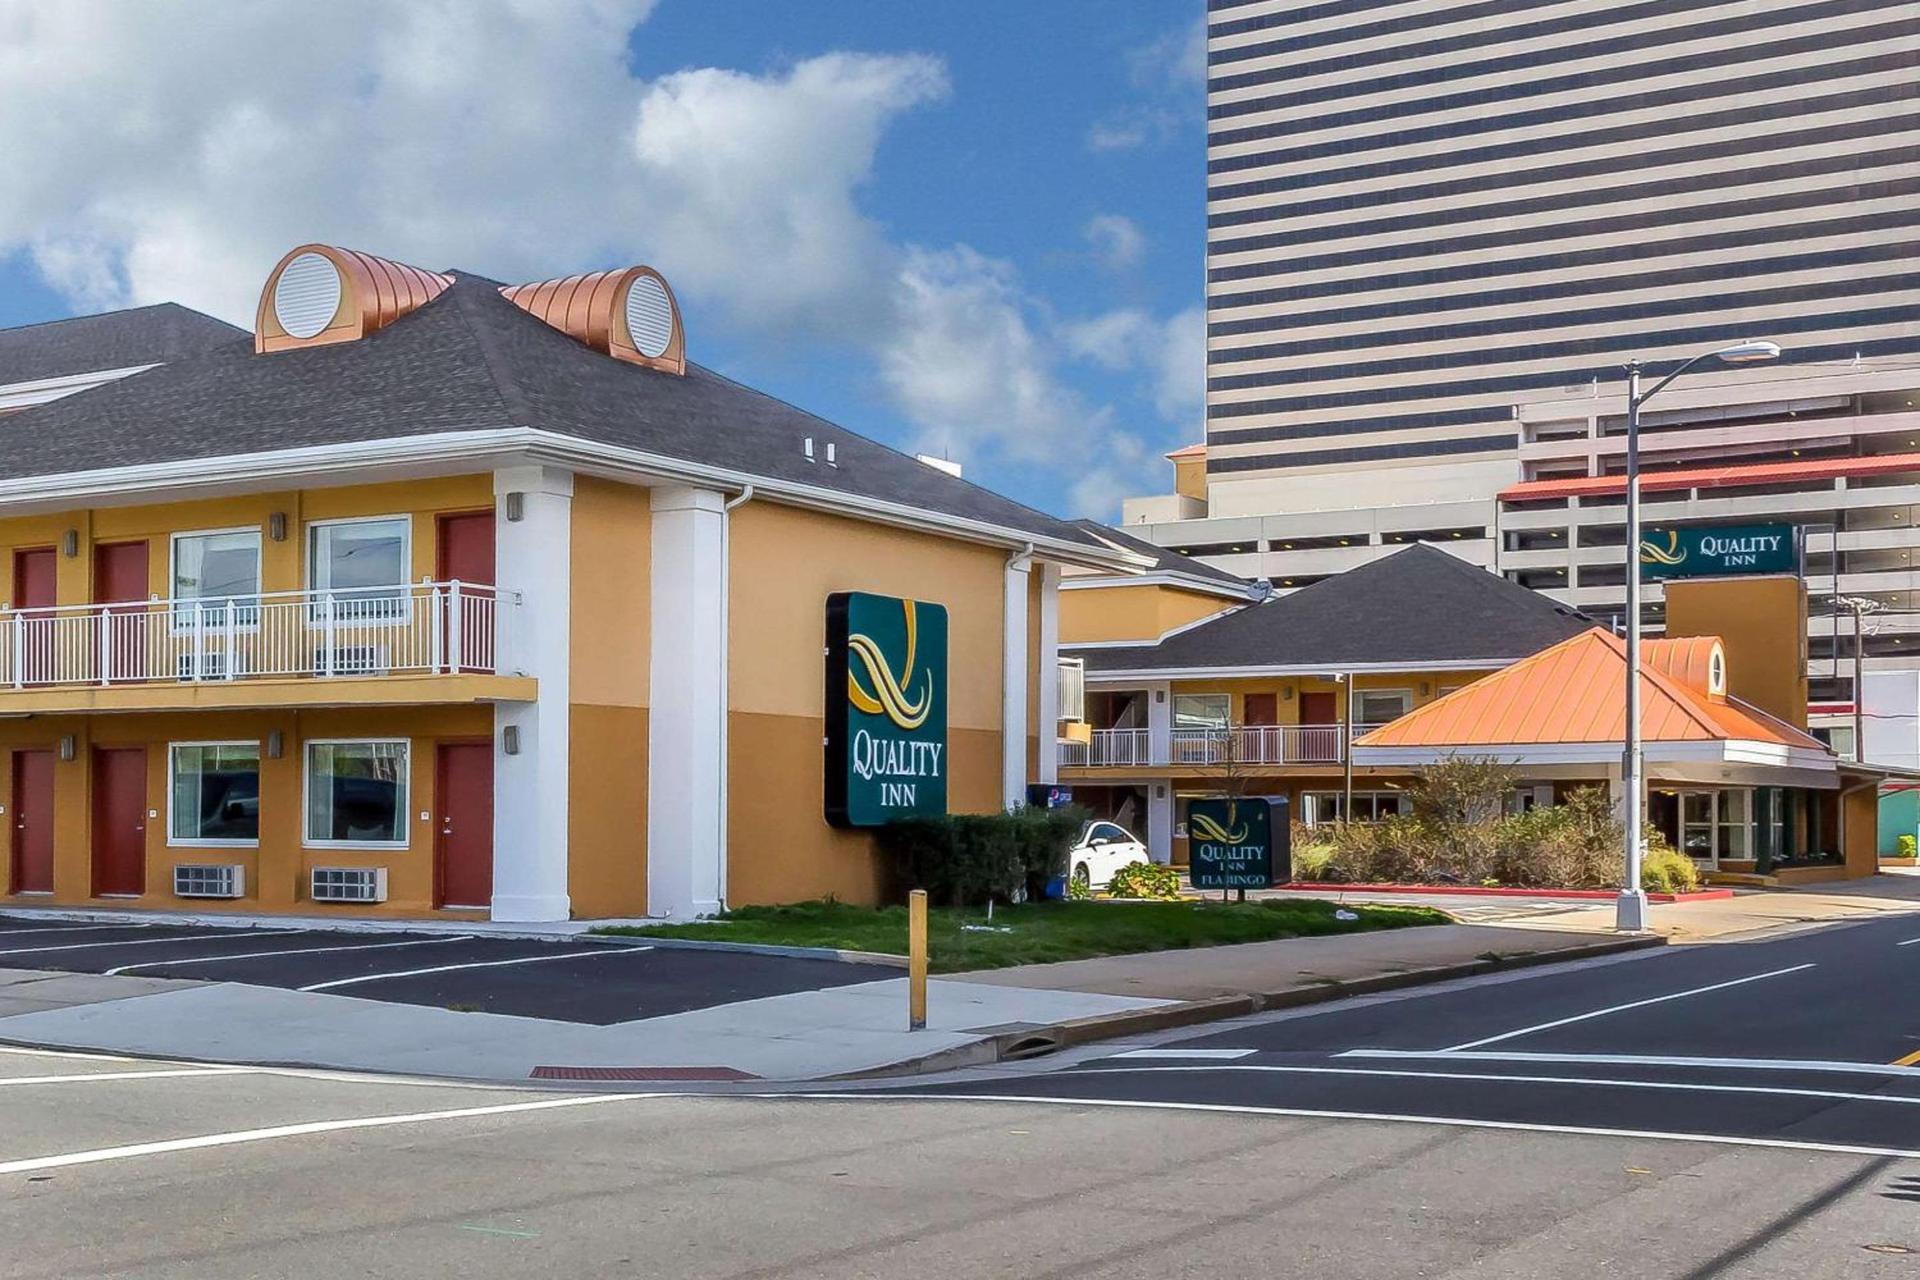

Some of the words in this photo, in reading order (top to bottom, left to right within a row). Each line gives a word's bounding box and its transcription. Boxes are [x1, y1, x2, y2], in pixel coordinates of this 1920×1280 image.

[1700, 536, 1781, 556] QUALITY
[1724, 554, 1756, 566] INN
[853, 729, 942, 780] QUALITY
[881, 783, 916, 807] INN
[1200, 844, 1264, 862] QUALITY
